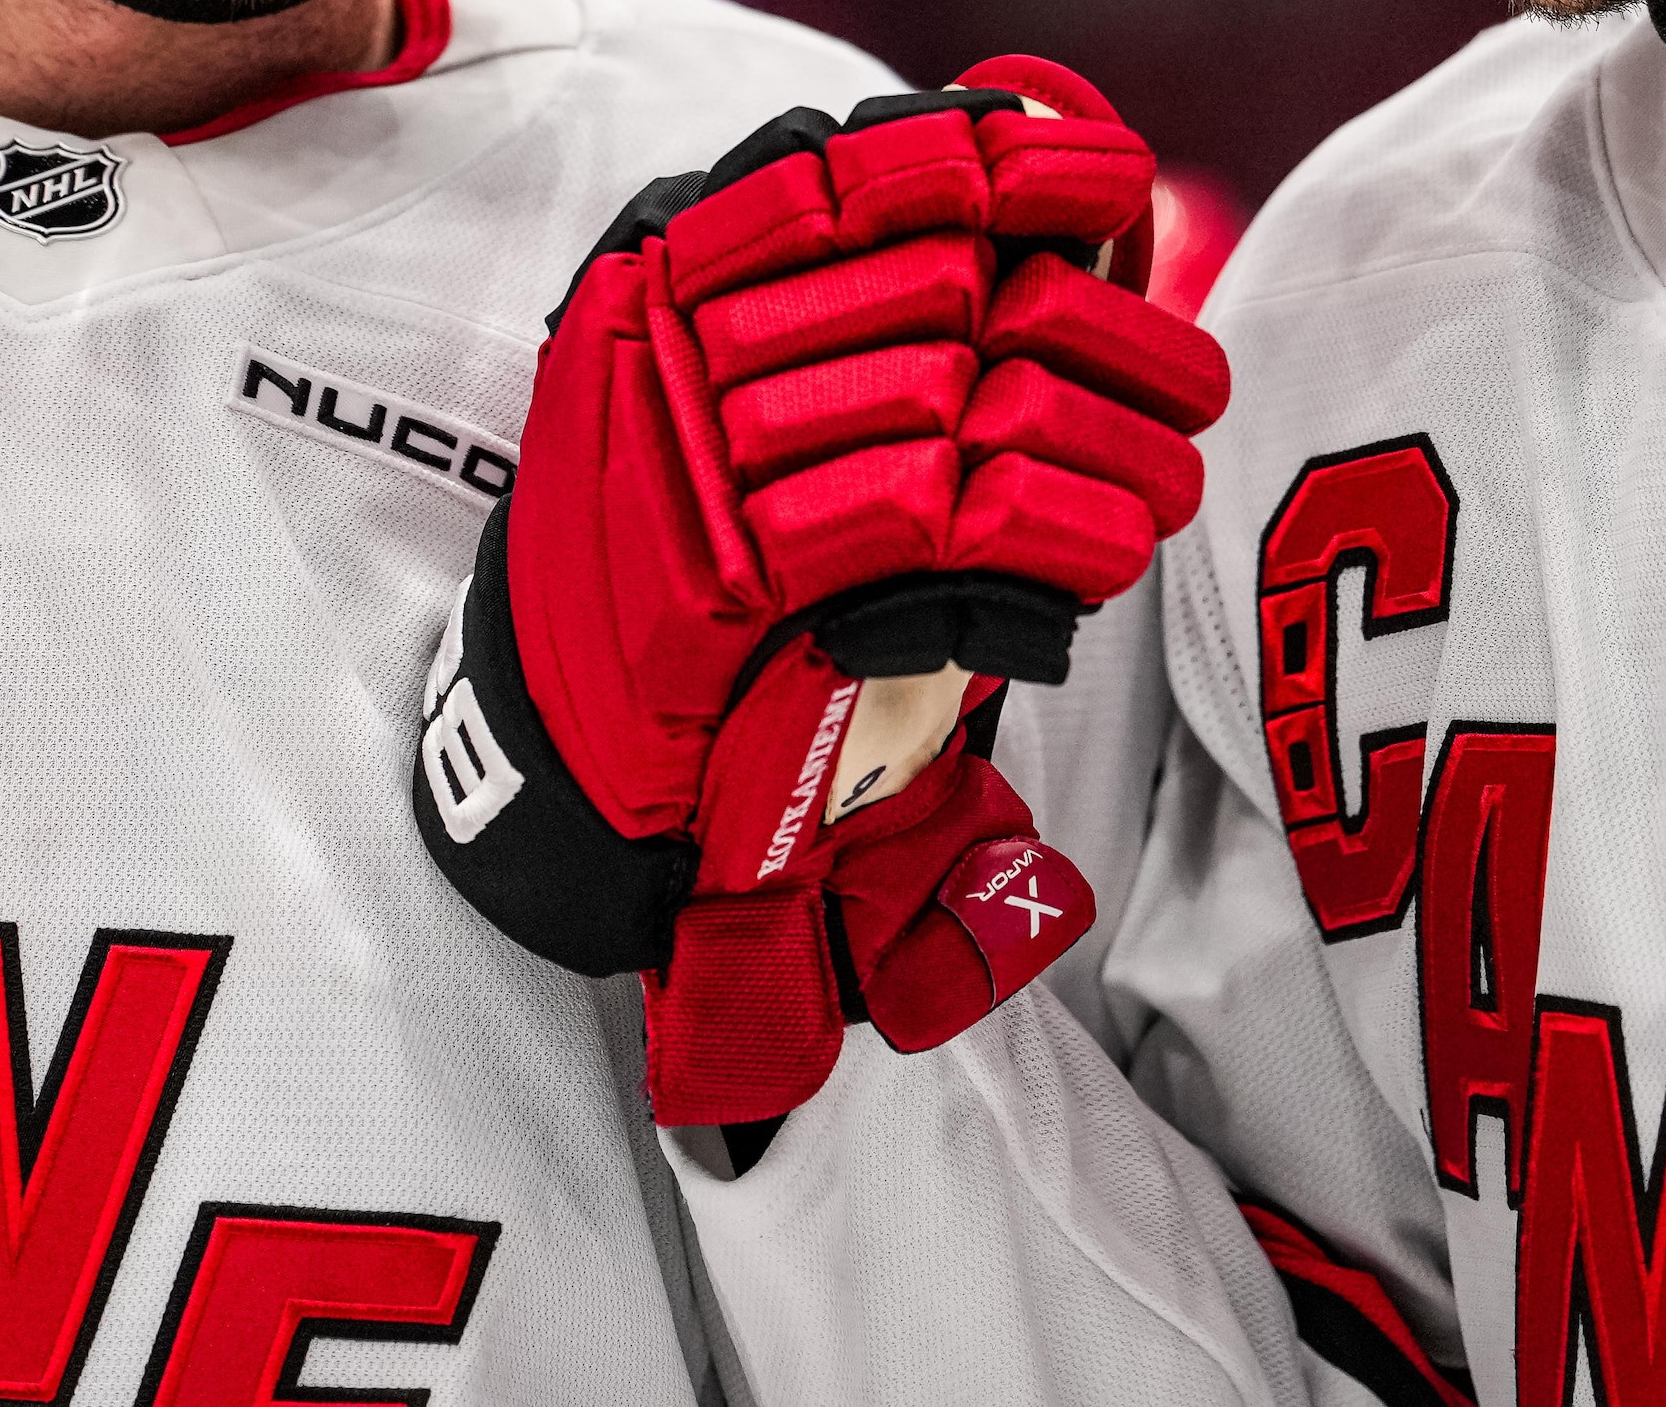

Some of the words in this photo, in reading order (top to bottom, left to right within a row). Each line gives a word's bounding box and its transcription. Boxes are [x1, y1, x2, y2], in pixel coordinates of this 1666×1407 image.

[10, 166, 99, 214] NHL
[241, 358, 519, 498] NUCO
[756, 680, 859, 881] KOTKANIEMI
[965, 847, 1044, 903] VAPOR
